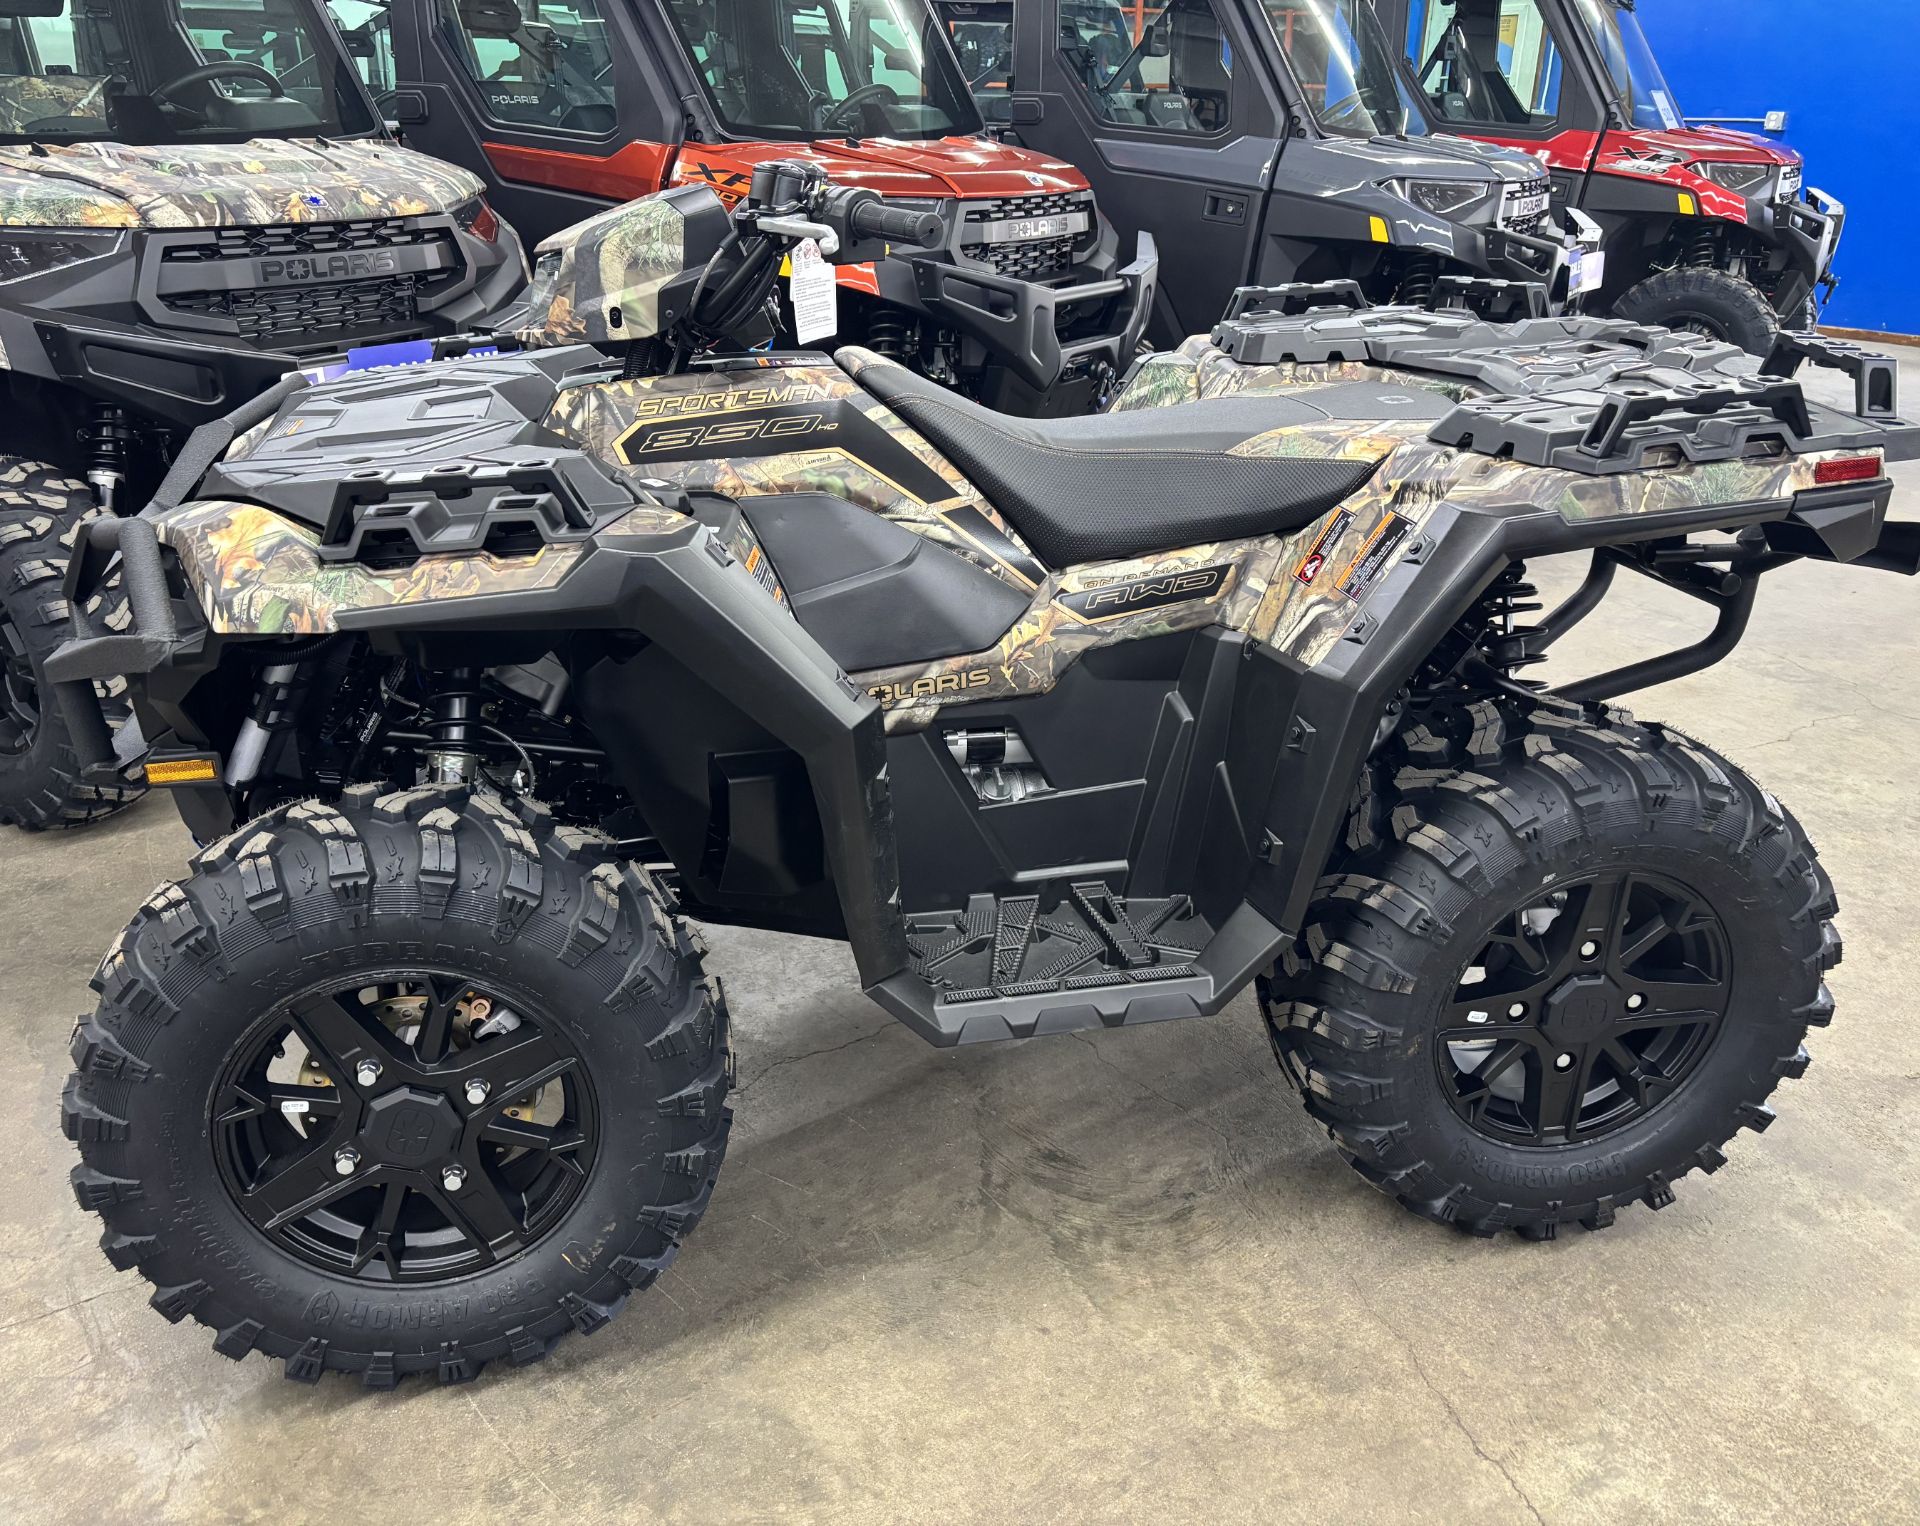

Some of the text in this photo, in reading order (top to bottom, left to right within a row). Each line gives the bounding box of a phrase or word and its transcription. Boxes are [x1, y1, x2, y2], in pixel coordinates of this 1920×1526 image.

[491, 95, 540, 104] POLARIS
[1603, 145, 1684, 163] XP
[1008, 216, 1069, 239] POLARIS
[260, 251, 395, 283] POLARIS
[635, 385, 833, 418] SPORTSMAN
[639, 414, 823, 453] 850
[1355, 530, 1380, 563] WARNING
[1083, 558, 1216, 589] ON DEMAND
[1085, 571, 1218, 609] AWD
[866, 668, 992, 703] OLARIS
[360, 711, 378, 742] POLARIS
